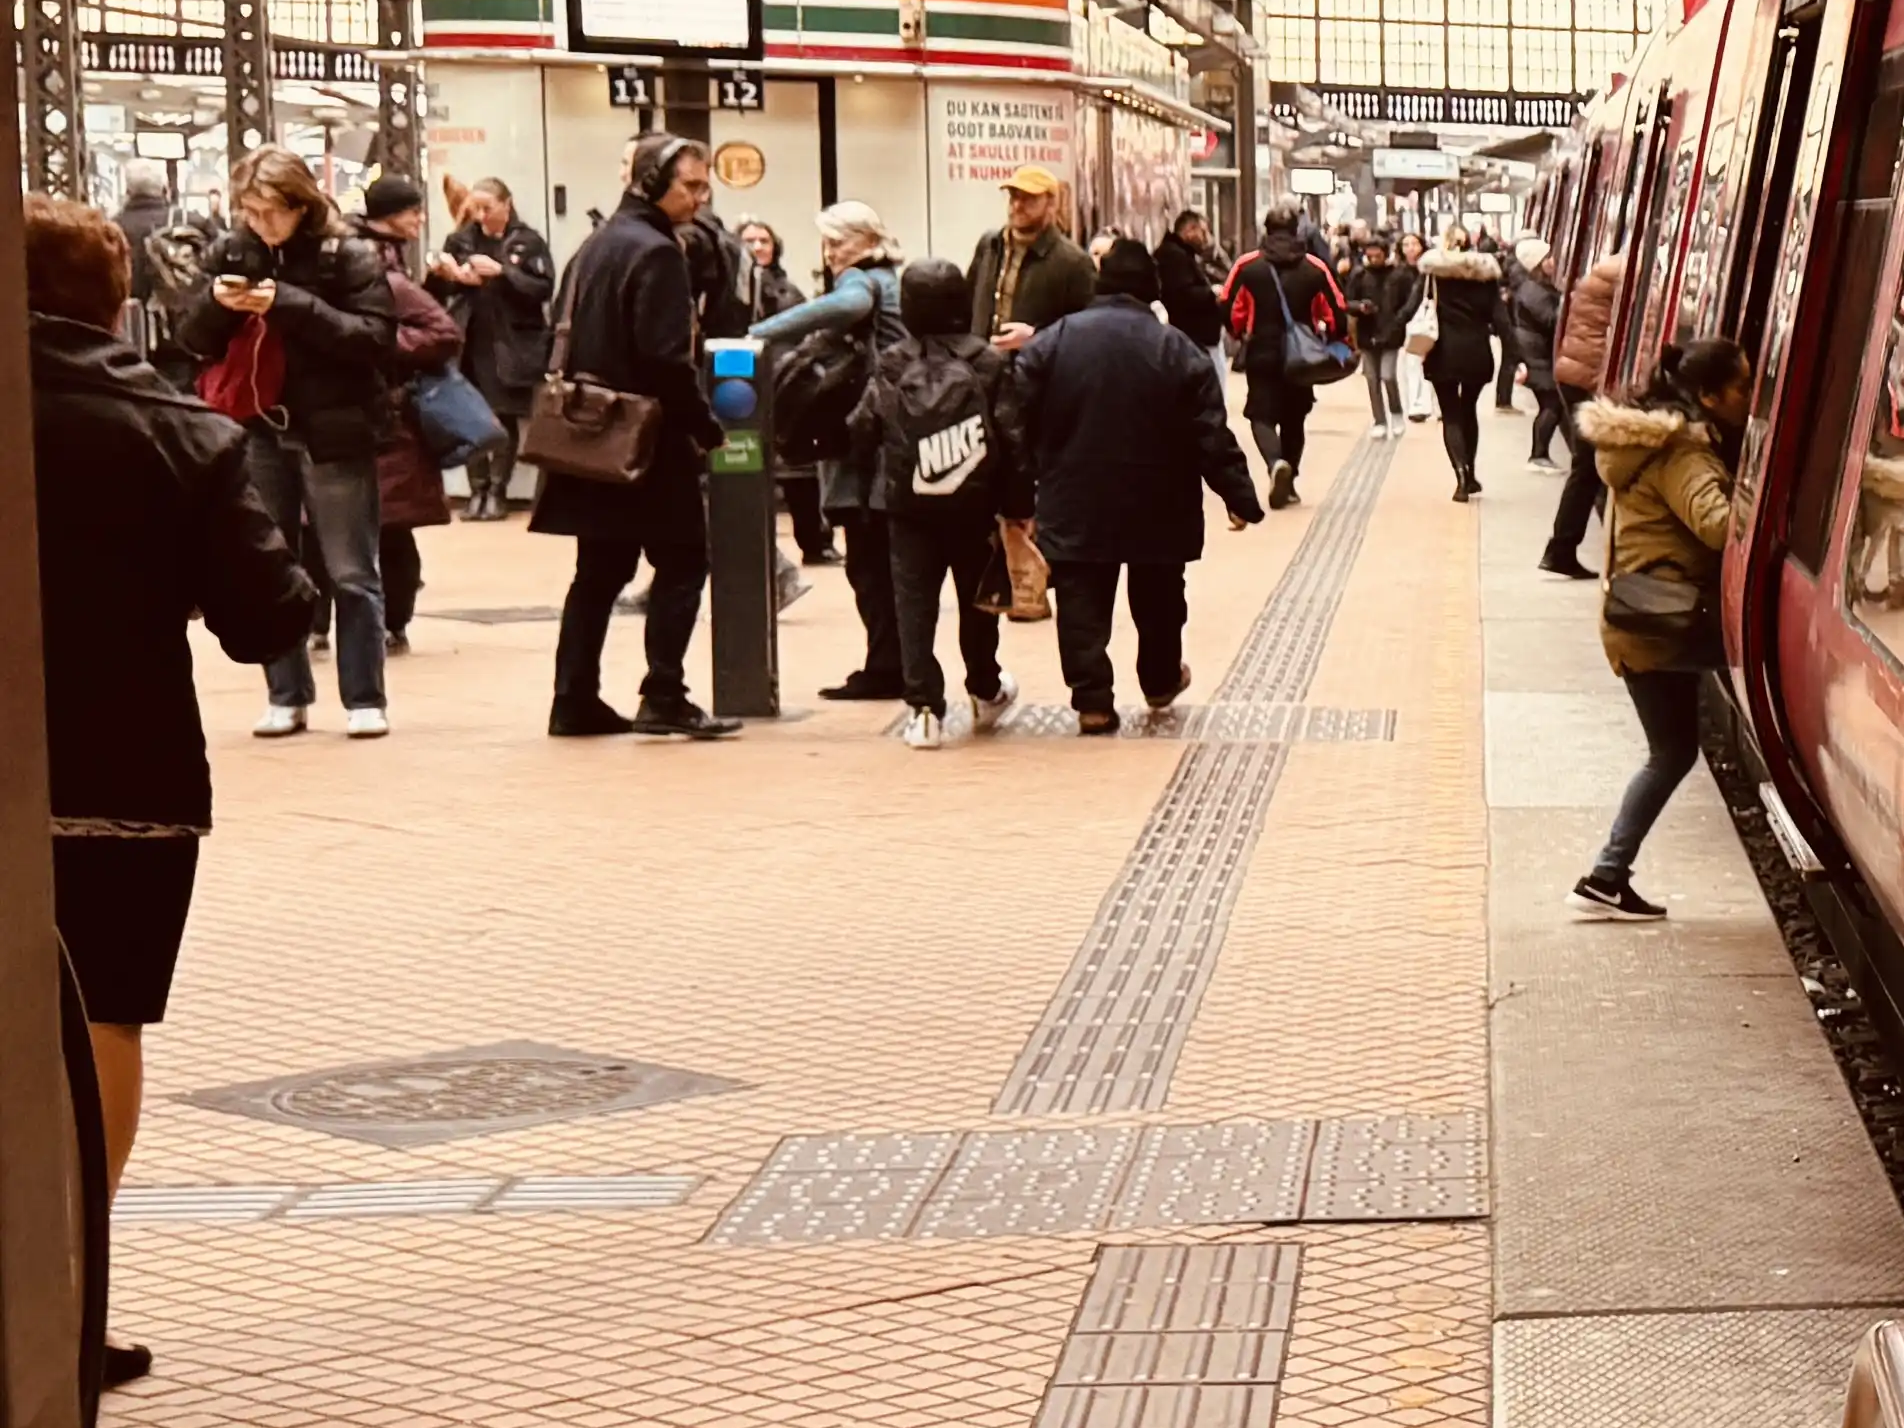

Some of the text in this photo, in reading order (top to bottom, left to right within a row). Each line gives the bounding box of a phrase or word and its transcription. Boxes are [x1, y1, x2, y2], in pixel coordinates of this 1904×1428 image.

[614, 79, 649, 104] 11
[723, 82, 759, 107] 12
[947, 100, 967, 117] DU
[971, 101, 1000, 118] KAN
[948, 143, 964, 158] AT
[918, 415, 986, 478] NIKE
